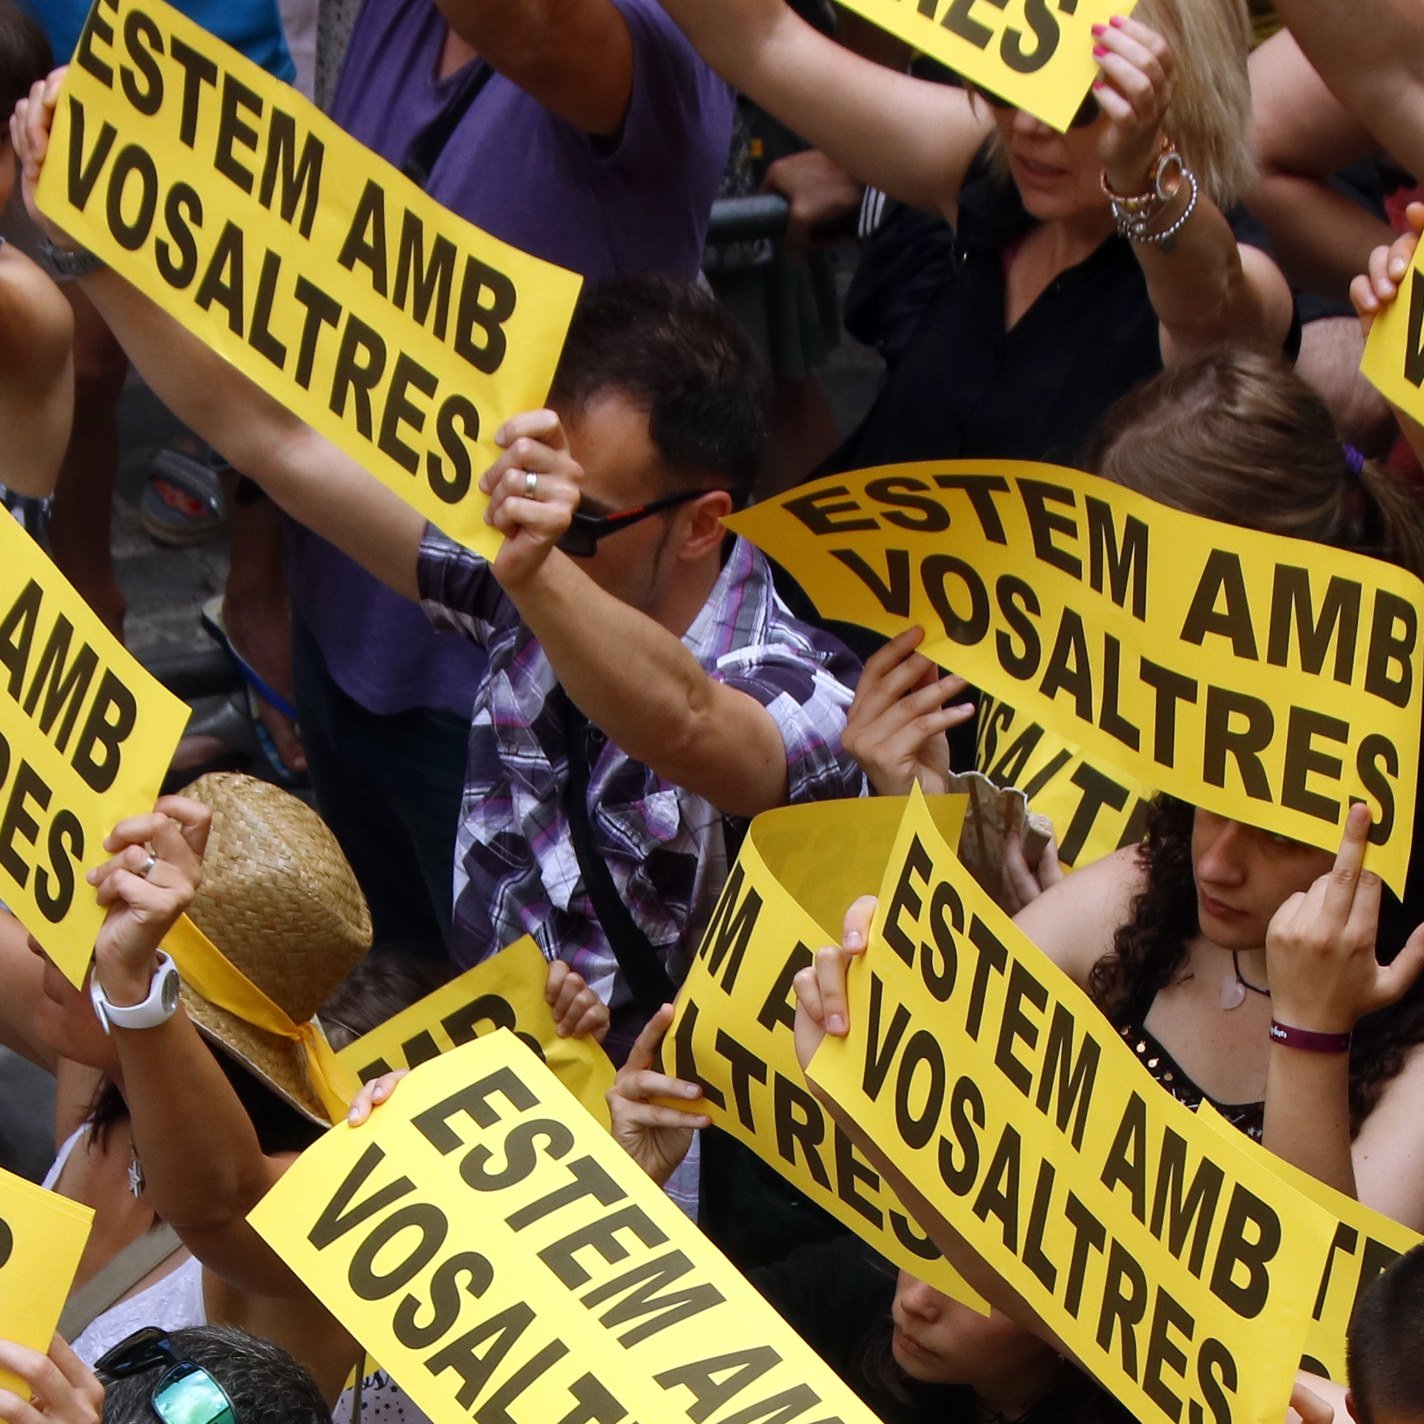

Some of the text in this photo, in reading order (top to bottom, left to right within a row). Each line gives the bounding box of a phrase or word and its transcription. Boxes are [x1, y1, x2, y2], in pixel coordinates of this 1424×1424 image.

[67, 96, 480, 504] VOSALTRES
[75, 0, 517, 376] ESTEM AMB
[780, 474, 1419, 709] ESTEM AMB
[828, 547, 1400, 848] VOSALTRES
[408, 1065, 728, 1351] ESTEM
[880, 832, 1282, 1321] ESTEM AMB
